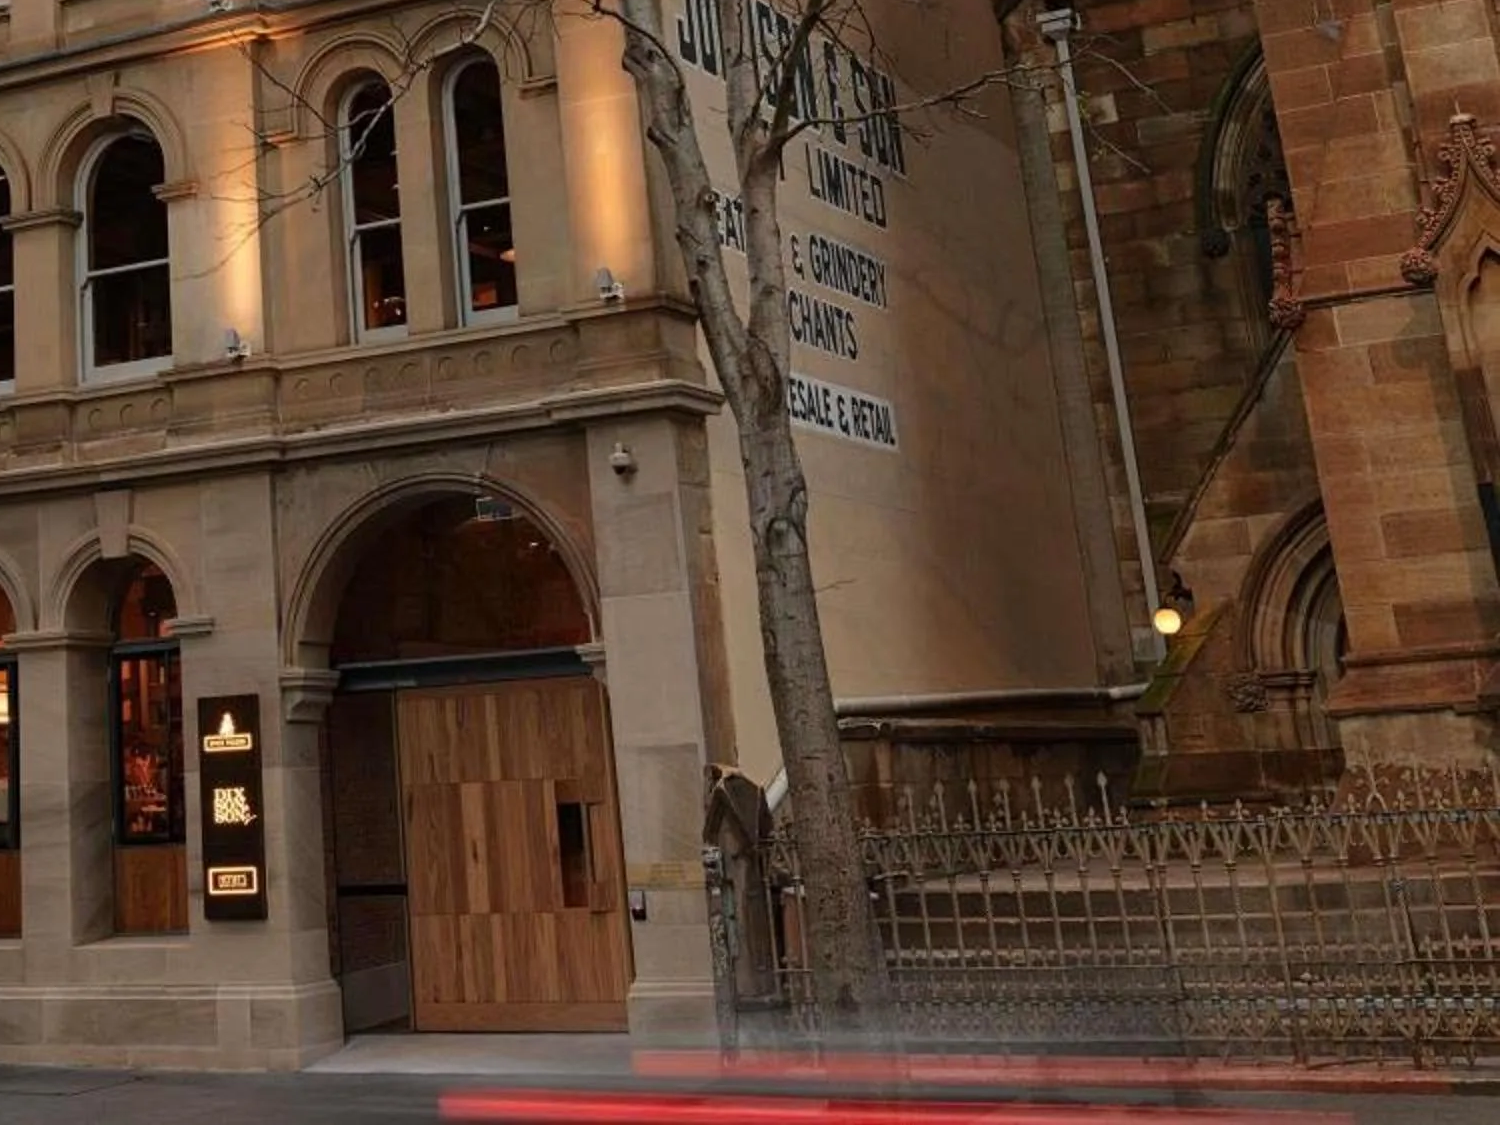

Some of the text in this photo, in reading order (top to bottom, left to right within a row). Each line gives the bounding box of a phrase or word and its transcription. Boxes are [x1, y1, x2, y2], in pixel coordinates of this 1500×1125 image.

[805, 141, 887, 228] LIMITED
[790, 234, 888, 309] & GRINDERY
[836, 394, 851, 435] &
[851, 396, 897, 446] RETAIL
